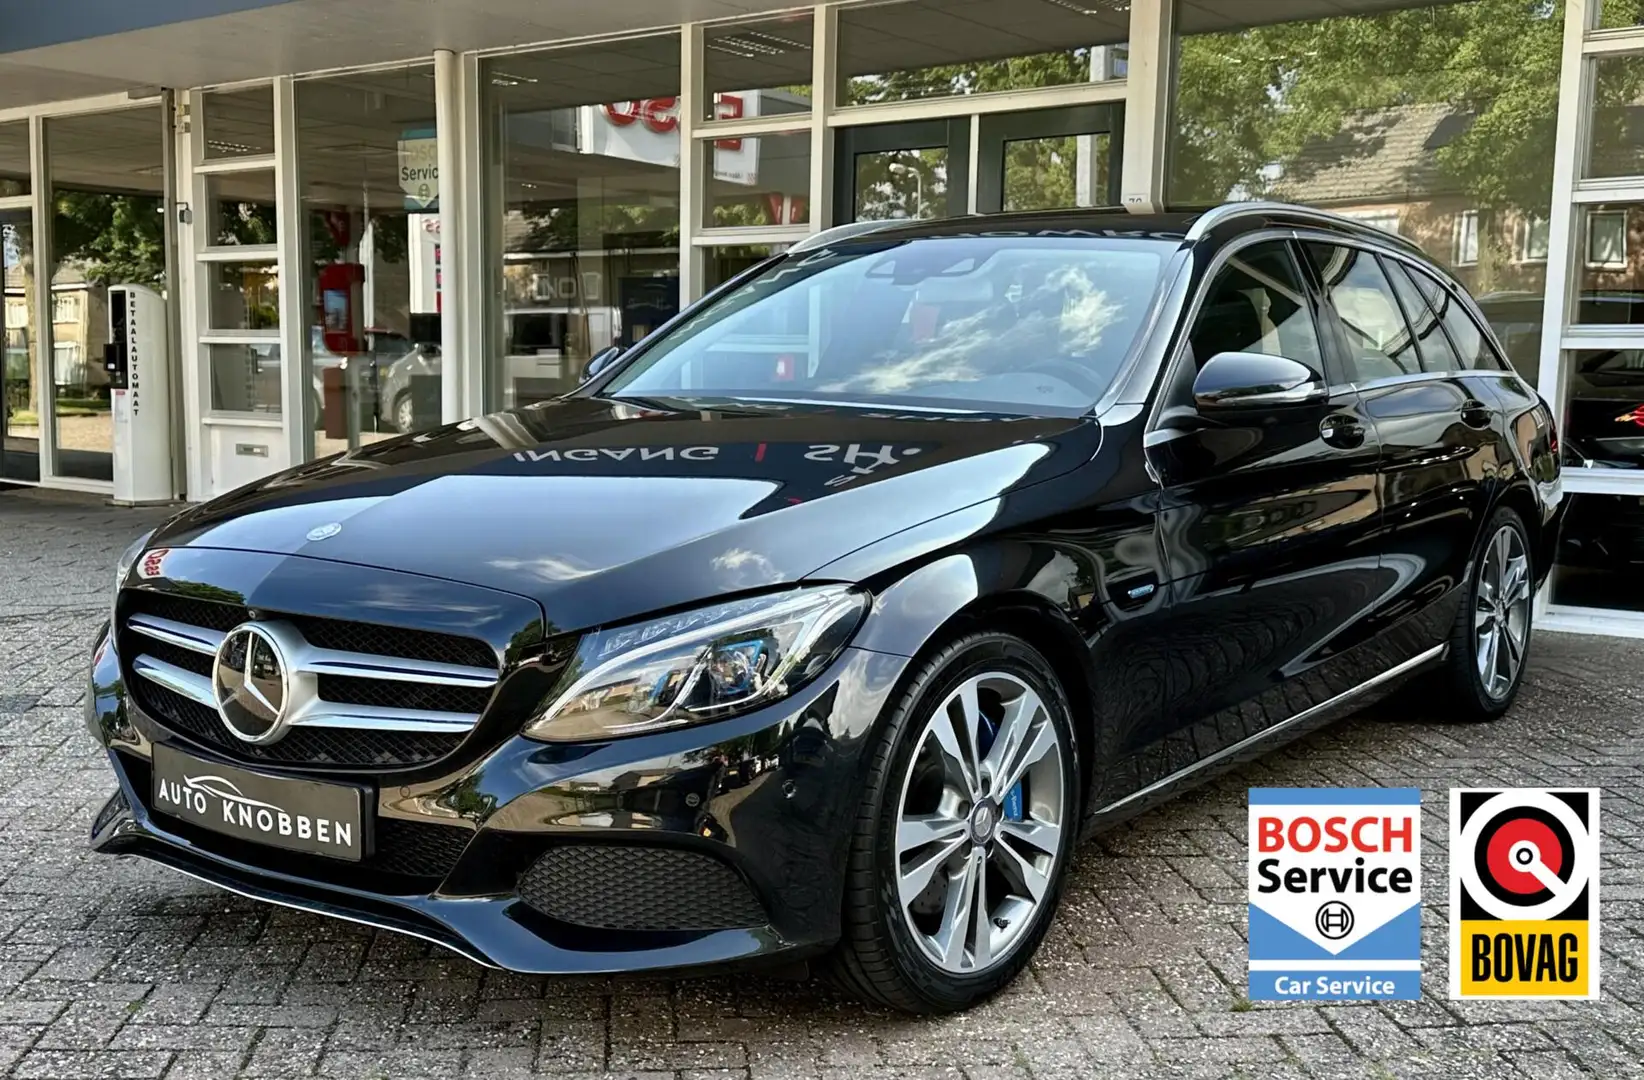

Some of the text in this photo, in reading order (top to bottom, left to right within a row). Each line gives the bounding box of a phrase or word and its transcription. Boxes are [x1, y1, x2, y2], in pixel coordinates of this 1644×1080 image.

[402, 164, 438, 182] Servic
[130, 291, 140, 416] BETAALAUTOMAAT
[159, 778, 352, 847] AUTO KNOBBEN
